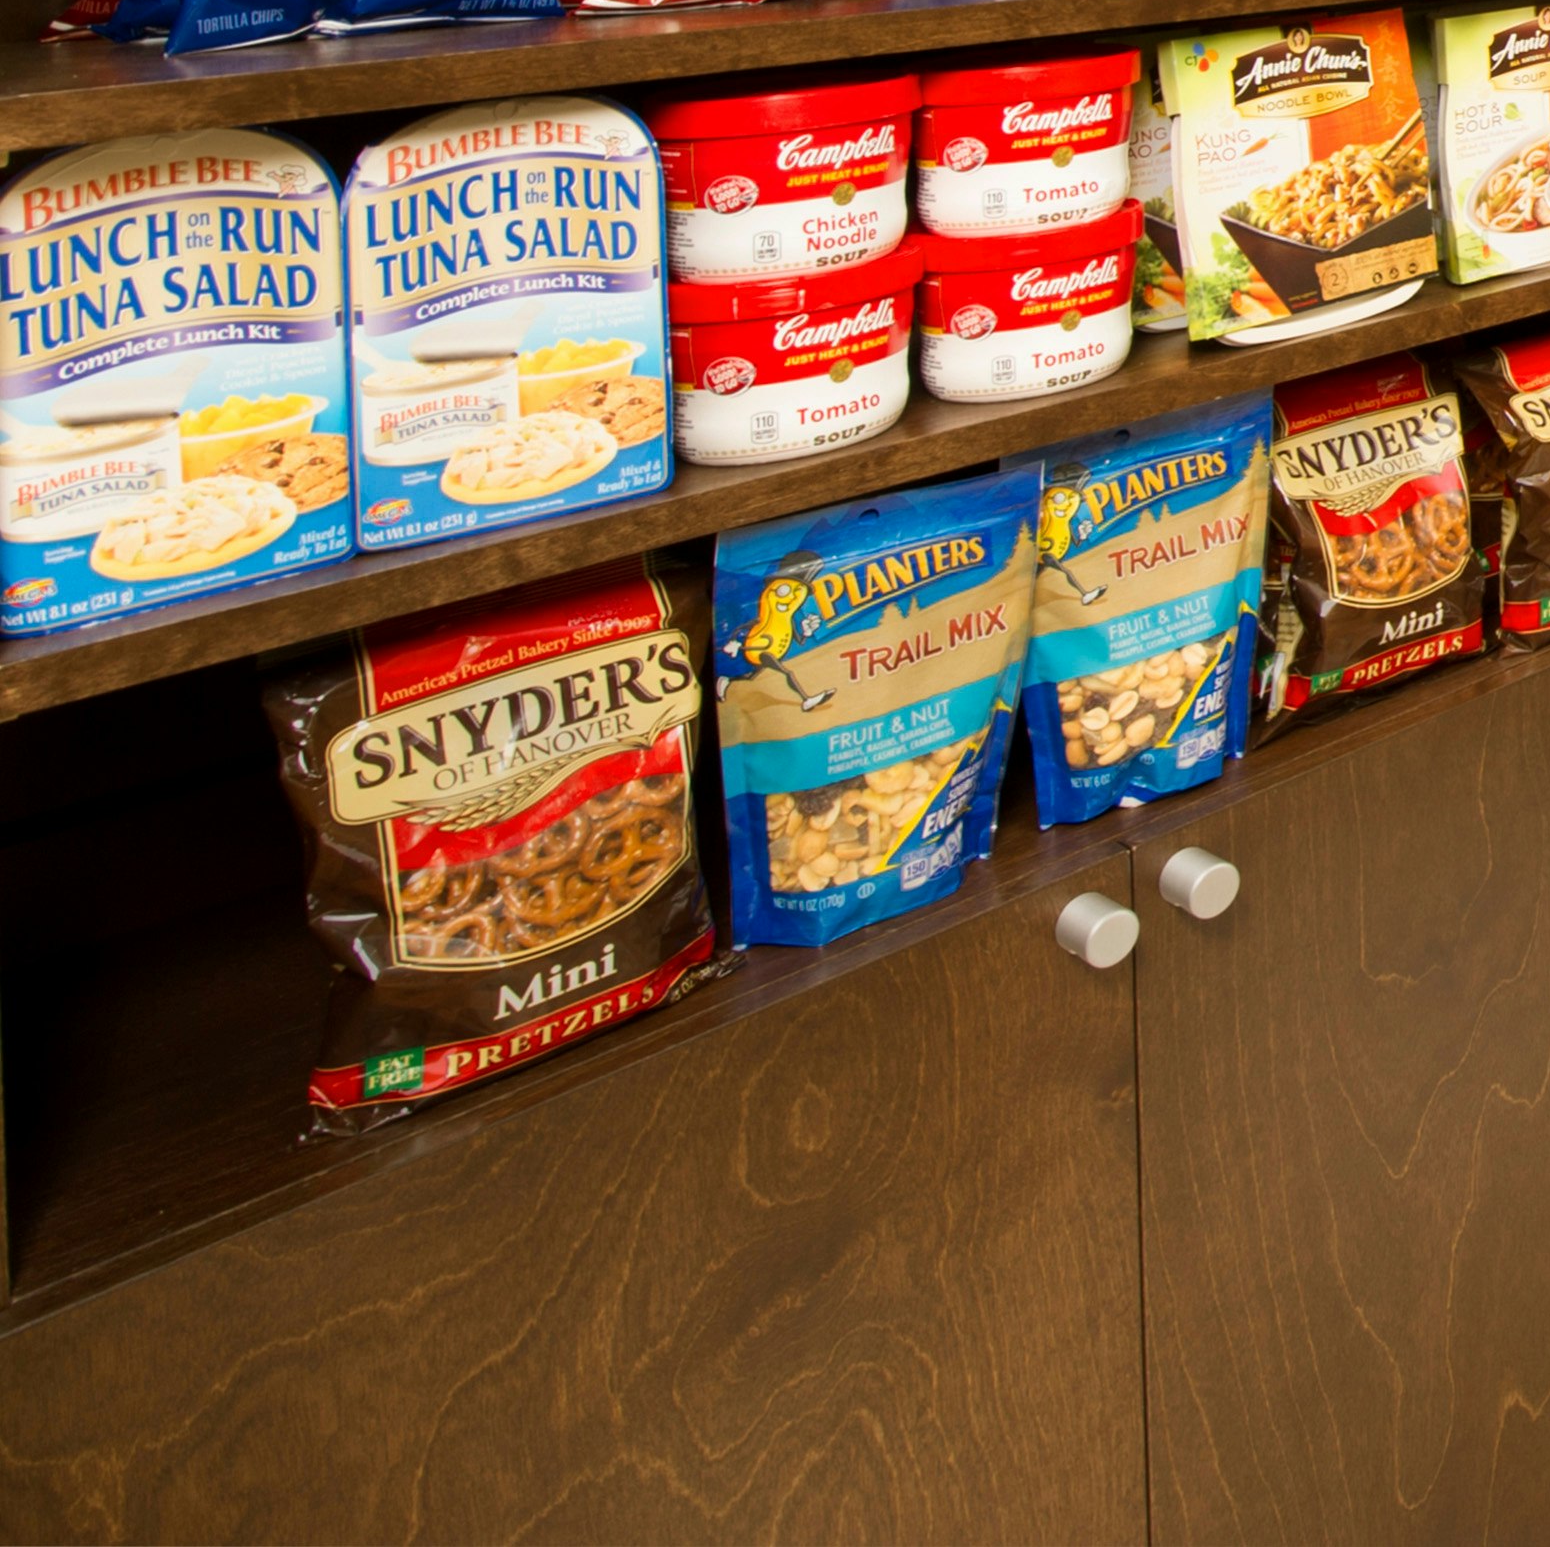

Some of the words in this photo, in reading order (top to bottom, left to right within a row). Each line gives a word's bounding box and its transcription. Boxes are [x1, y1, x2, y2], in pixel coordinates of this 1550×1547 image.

[196, 13, 249, 36] TORTILLA
[250, 7, 285, 31] CHIPS
[1235, 52, 1301, 98] Annie
[1256, 94, 1310, 114] NOODLE
[1316, 88, 1352, 103] BOWL
[1455, 115, 1504, 135] SOUR
[386, 122, 530, 188] BUMBLE
[533, 119, 593, 146] BEE
[1194, 128, 1251, 151] KUNG
[1197, 145, 1238, 167] PAO
[22, 159, 189, 234] BUMBLE
[195, 155, 263, 186] BEE
[552, 165, 642, 212] RUN
[785, 173, 819, 188] JUST
[821, 168, 852, 182] HEAT
[1023, 177, 1100, 204] Tomato
[185, 231, 214, 250] the
[219, 206, 321, 255] RUN
[365, 168, 519, 250] LUNCH
[802, 210, 879, 235] Chicken
[0, 209, 180, 303] LUNCH
[187, 212, 211, 228] on
[375, 226, 492, 299] TUNA
[504, 216, 639, 263] SALAD
[759, 234, 775, 248] 70
[806, 226, 878, 253] Noodle
[815, 248, 869, 268] SOUP
[9, 276, 147, 358] TUNA
[163, 261, 318, 314] SALAD
[415, 279, 510, 322] Complete
[512, 273, 575, 292] Lunch
[576, 272, 607, 291] Kit
[58, 333, 169, 381] Complete
[173, 323, 244, 347] Lunch
[248, 323, 282, 341] Kit
[1032, 340, 1105, 368] Tomato
[796, 391, 881, 425] Tomato
[1275, 402, 1459, 480] SNYDER'S
[1084, 450, 1228, 525] PLANTERS
[1346, 451, 1428, 486] HANOVER
[1107, 533, 1198, 582] TRAIL
[1200, 511, 1251, 549] MIX
[810, 535, 986, 621] PLANTERS
[1107, 613, 1151, 641] FRUIT
[1173, 594, 1210, 619] NUT
[1378, 601, 1445, 646] Mini
[839, 628, 944, 684] TRAIL
[948, 602, 1009, 651] MIX
[1350, 634, 1465, 686] PRETZELS
[379, 667, 458, 706] America's
[460, 649, 515, 680] Pretzel
[518, 634, 569, 661] Bakery
[351, 640, 696, 792] SNYDER'S
[827, 721, 885, 753] FRUIT
[890, 716, 905, 734] &
[910, 698, 951, 728] NUT
[432, 762, 475, 793] OF
[483, 711, 635, 777] HANOVER
[906, 859, 927, 877] 150
[491, 943, 619, 1024] Mini
[444, 983, 655, 1081] PRETZELS
[366, 1064, 424, 1091] FREE
[377, 1053, 415, 1074] FAT
